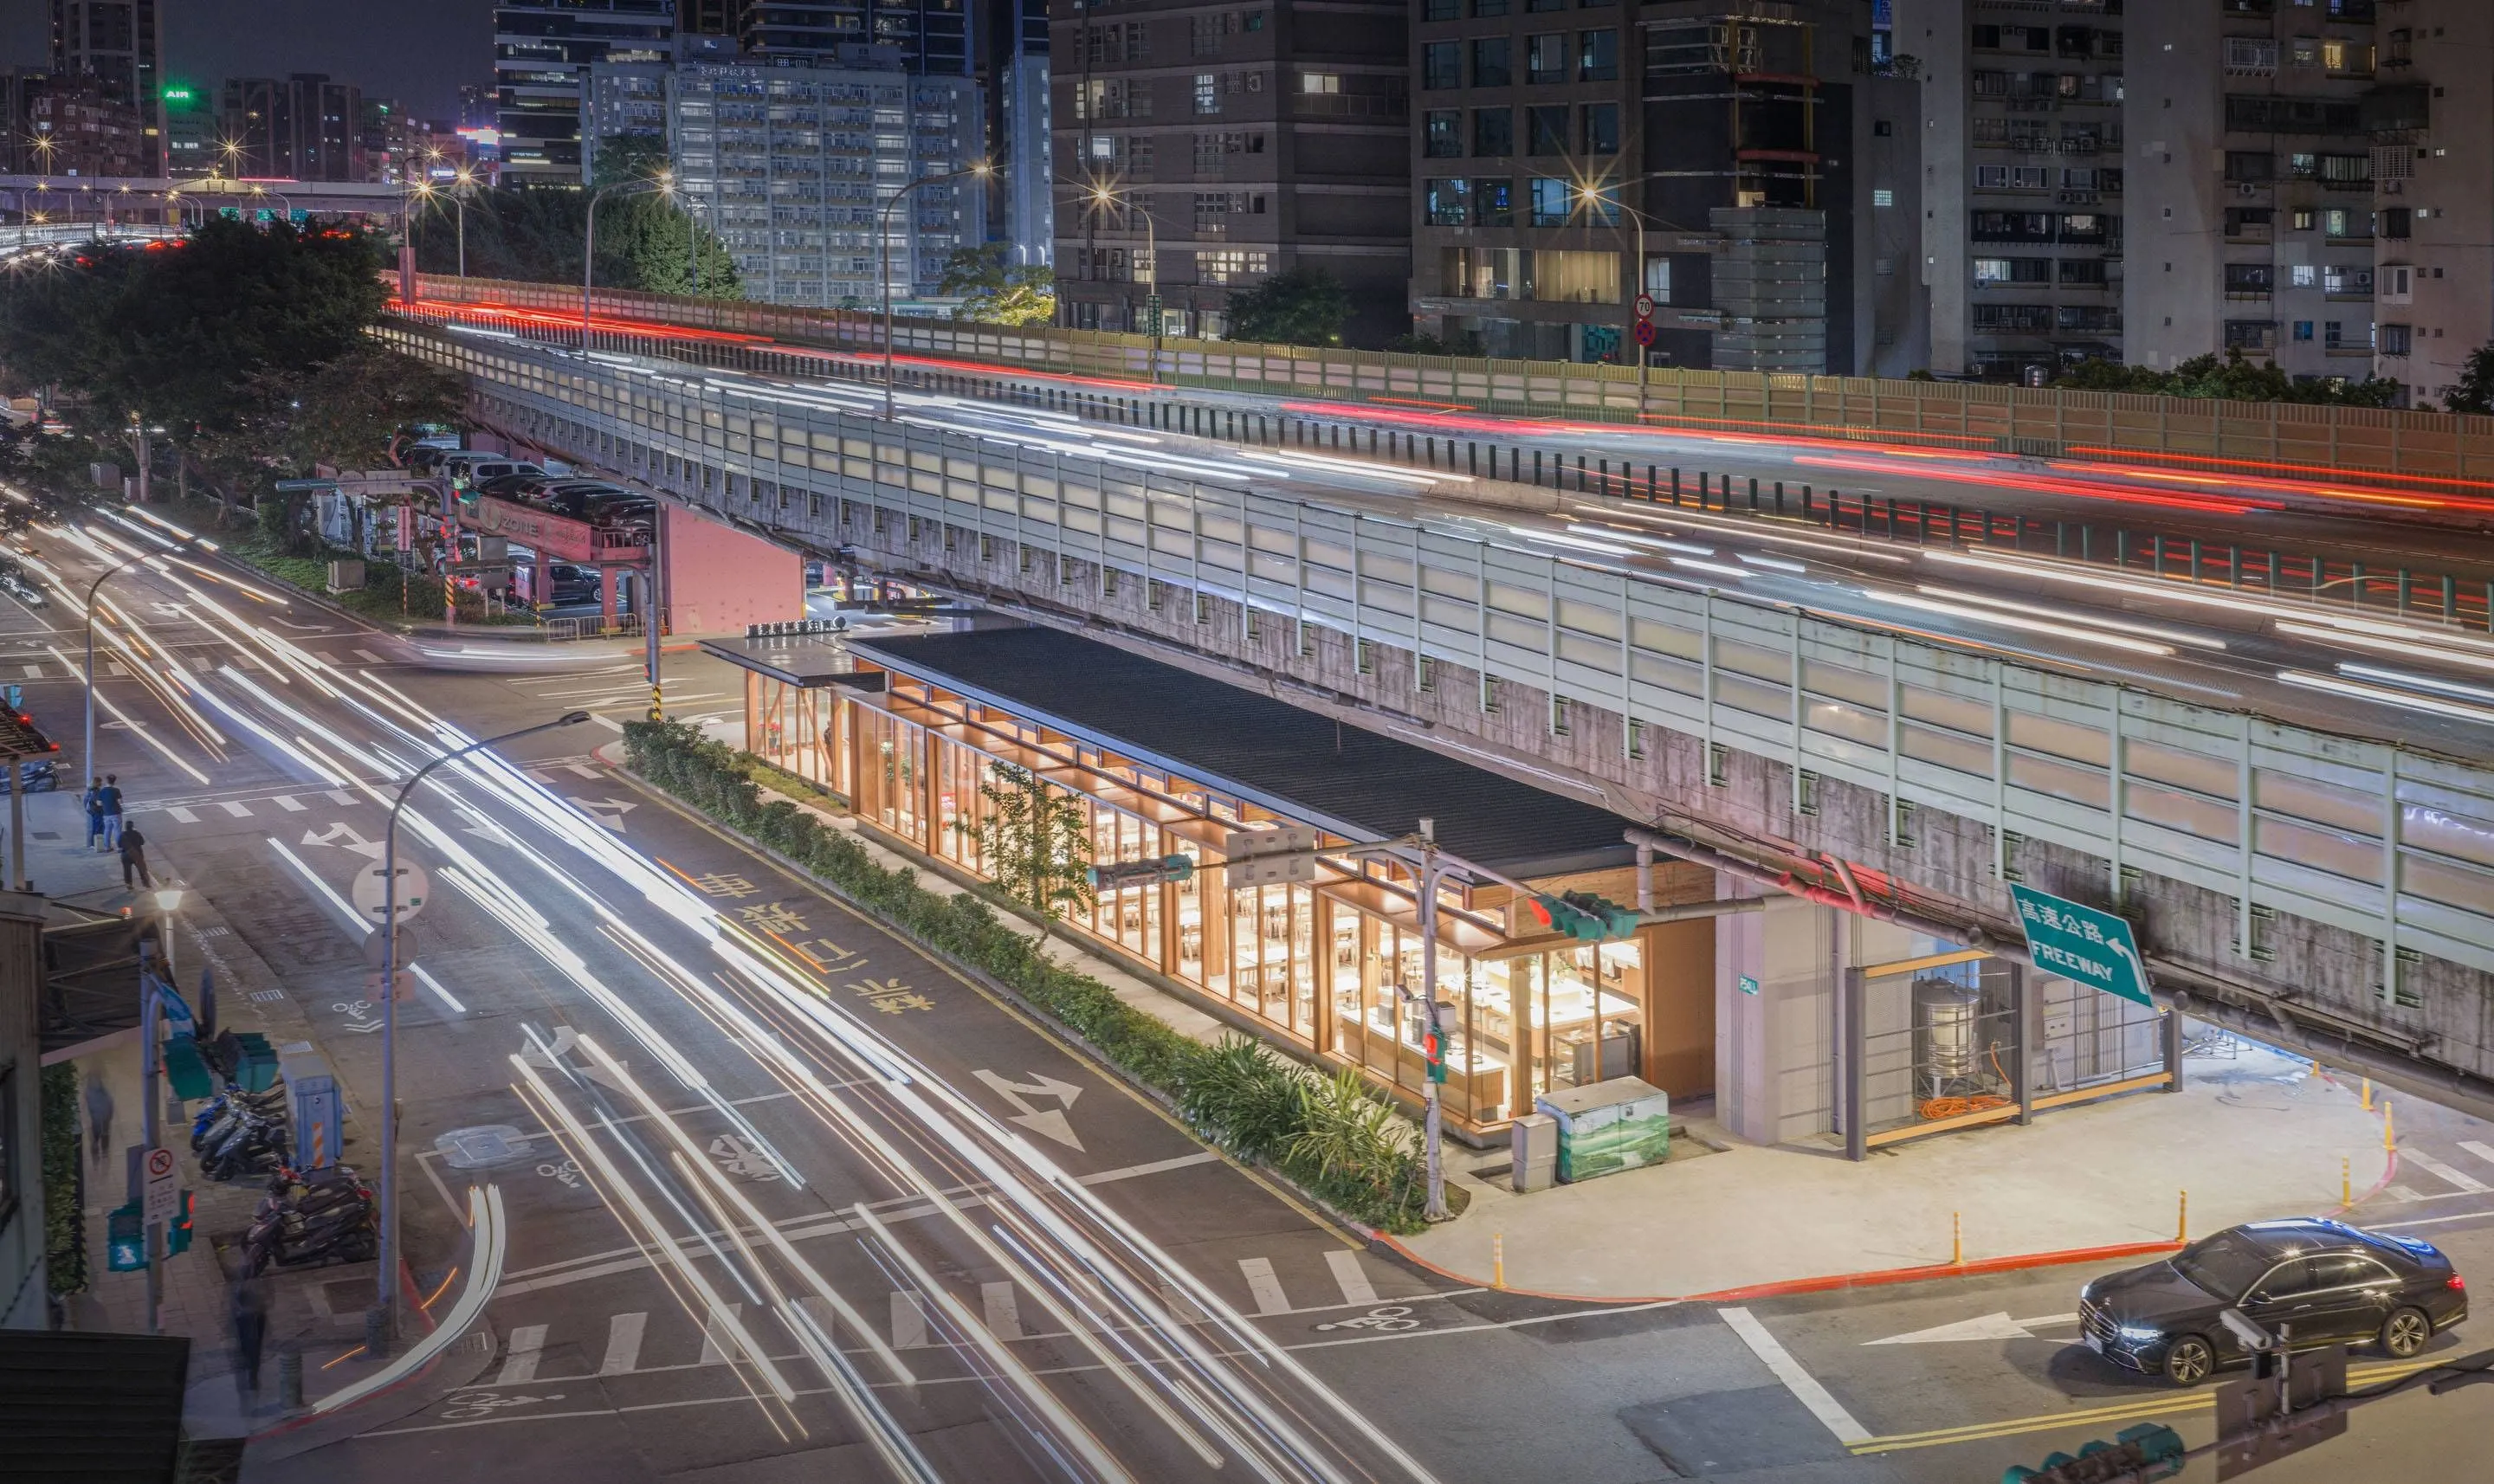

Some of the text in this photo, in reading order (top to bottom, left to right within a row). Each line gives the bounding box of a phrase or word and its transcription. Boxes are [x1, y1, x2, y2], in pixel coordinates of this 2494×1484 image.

[1639, 302, 1650, 312] 70
[504, 518, 539, 537] ZONE
[2018, 899, 2104, 945] 高速公路
[2031, 940, 2113, 981] FREEWAY
